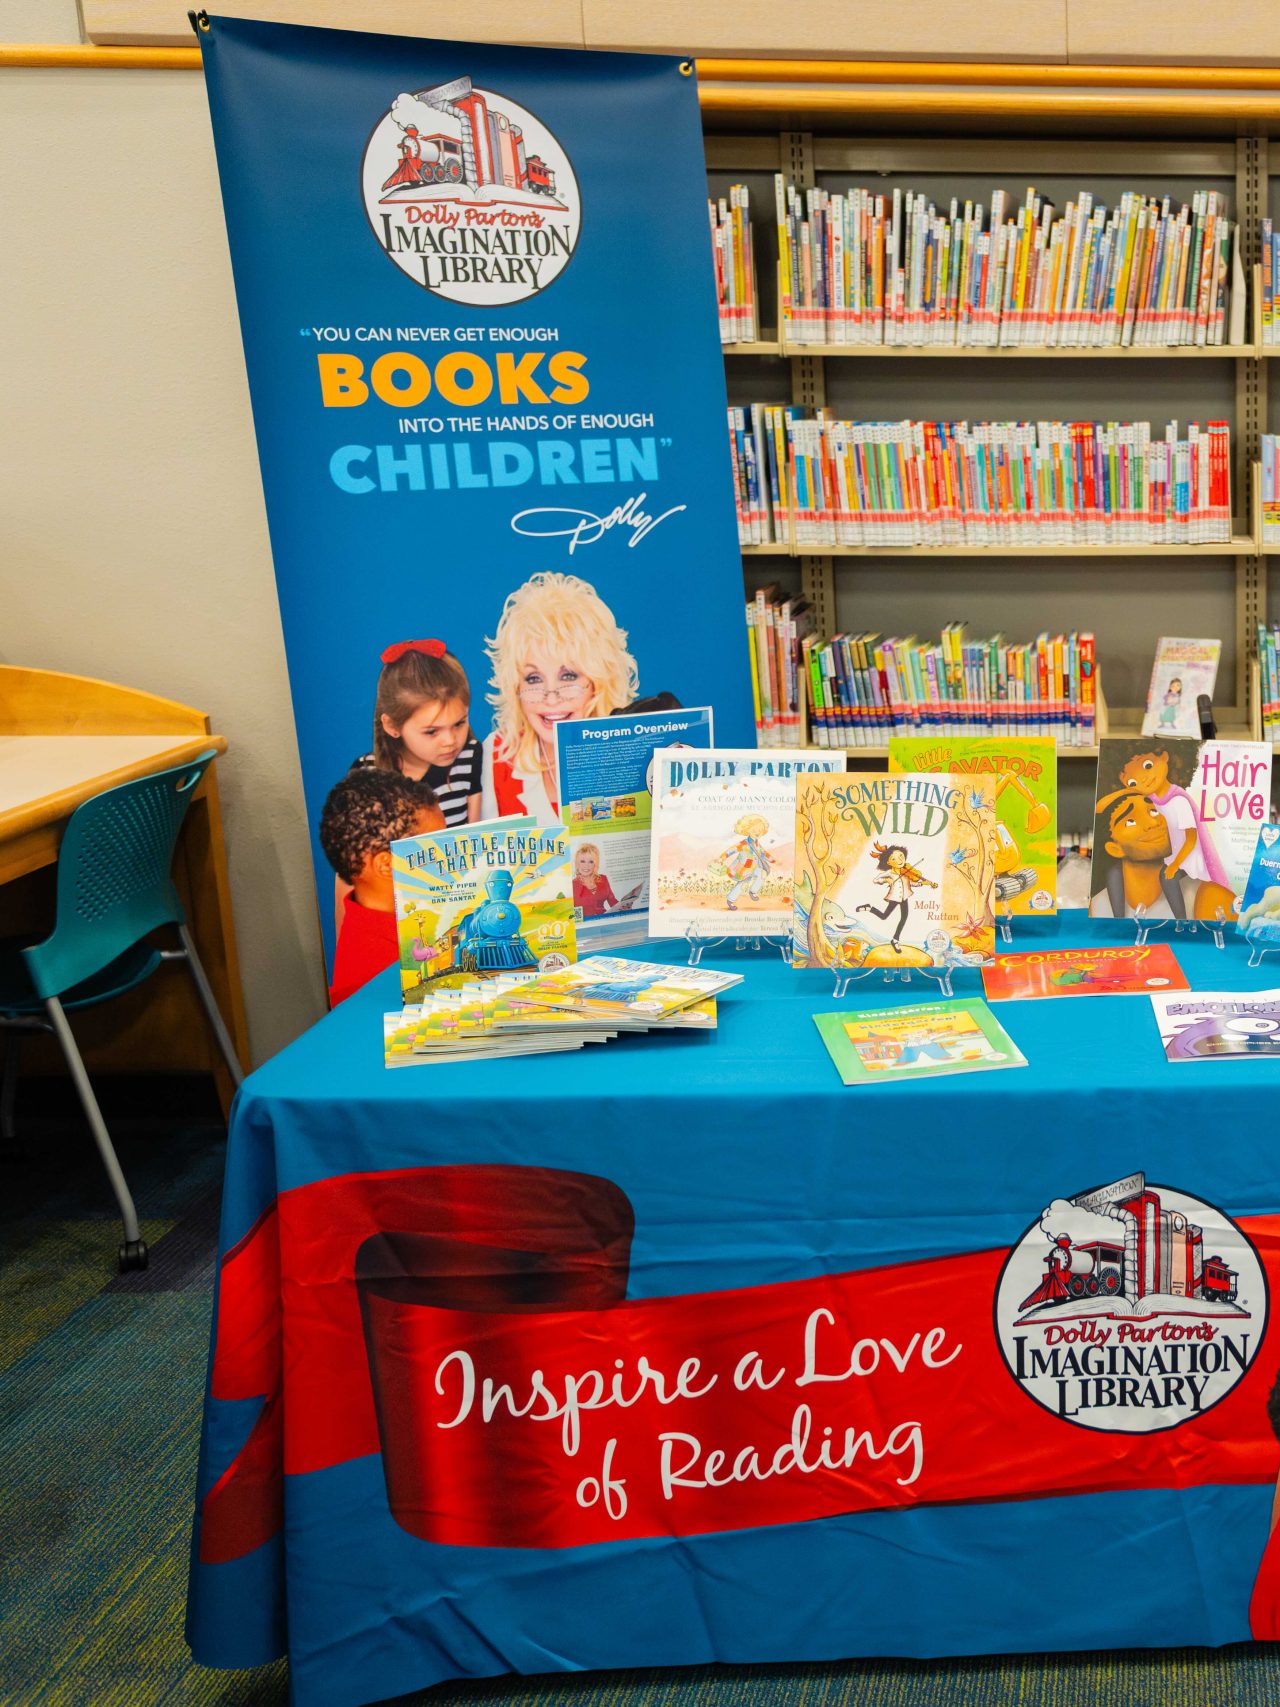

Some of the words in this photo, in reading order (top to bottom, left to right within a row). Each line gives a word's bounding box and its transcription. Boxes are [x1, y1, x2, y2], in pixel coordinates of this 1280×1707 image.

[405, 205, 460, 228] Dolly
[465, 207, 546, 228] Parton's
[380, 213, 571, 257] IMAGINATION
[421, 255, 544, 290] LIBRARY
[354, 328, 392, 342] CAN
[396, 327, 451, 342] NEVER
[454, 327, 485, 342] GET
[489, 327, 559, 342] ENOUGH
[317, 351, 591, 408] BOOKS
[399, 417, 443, 434] INTO
[447, 416, 483, 432] THE
[487, 415, 549, 432] HANDS
[552, 414, 577, 430] OF
[580, 413, 654, 430] ENOUGH
[582, 727, 632, 740] Program
[633, 721, 689, 736] Overview
[670, 761, 740, 788] DOLLY
[750, 760, 836, 779] PARTON
[1201, 750, 1268, 788] Hair
[698, 795, 724, 803] COAT
[738, 795, 768, 803] MANY
[832, 779, 964, 811] SOMETHING
[1199, 789, 1265, 822] Love
[841, 801, 950, 838] WILD
[405, 846, 436, 869] THE
[443, 836, 499, 857] LITTLE
[507, 835, 566, 857] ENGINE
[436, 855, 481, 876] THAT
[486, 850, 538, 867] COULD
[428, 884, 454, 892] WATTY
[448, 894, 477, 904] SANTAT
[914, 900, 941, 914] Molly
[926, 911, 960, 921] Ruttan
[1000, 946, 1153, 968] CORDUROY
[1043, 1320, 1113, 1349] Dolly
[1116, 1319, 1220, 1344] Parton's
[1012, 1333, 1251, 1380] IMAGINATION
[434, 1350, 720, 1457] Inspire
[733, 1350, 787, 1392] a
[794, 1306, 963, 1388] Love
[1055, 1375, 1211, 1416] LIBRARY
[575, 1438, 629, 1521] of
[658, 1402, 926, 1501] Reading
